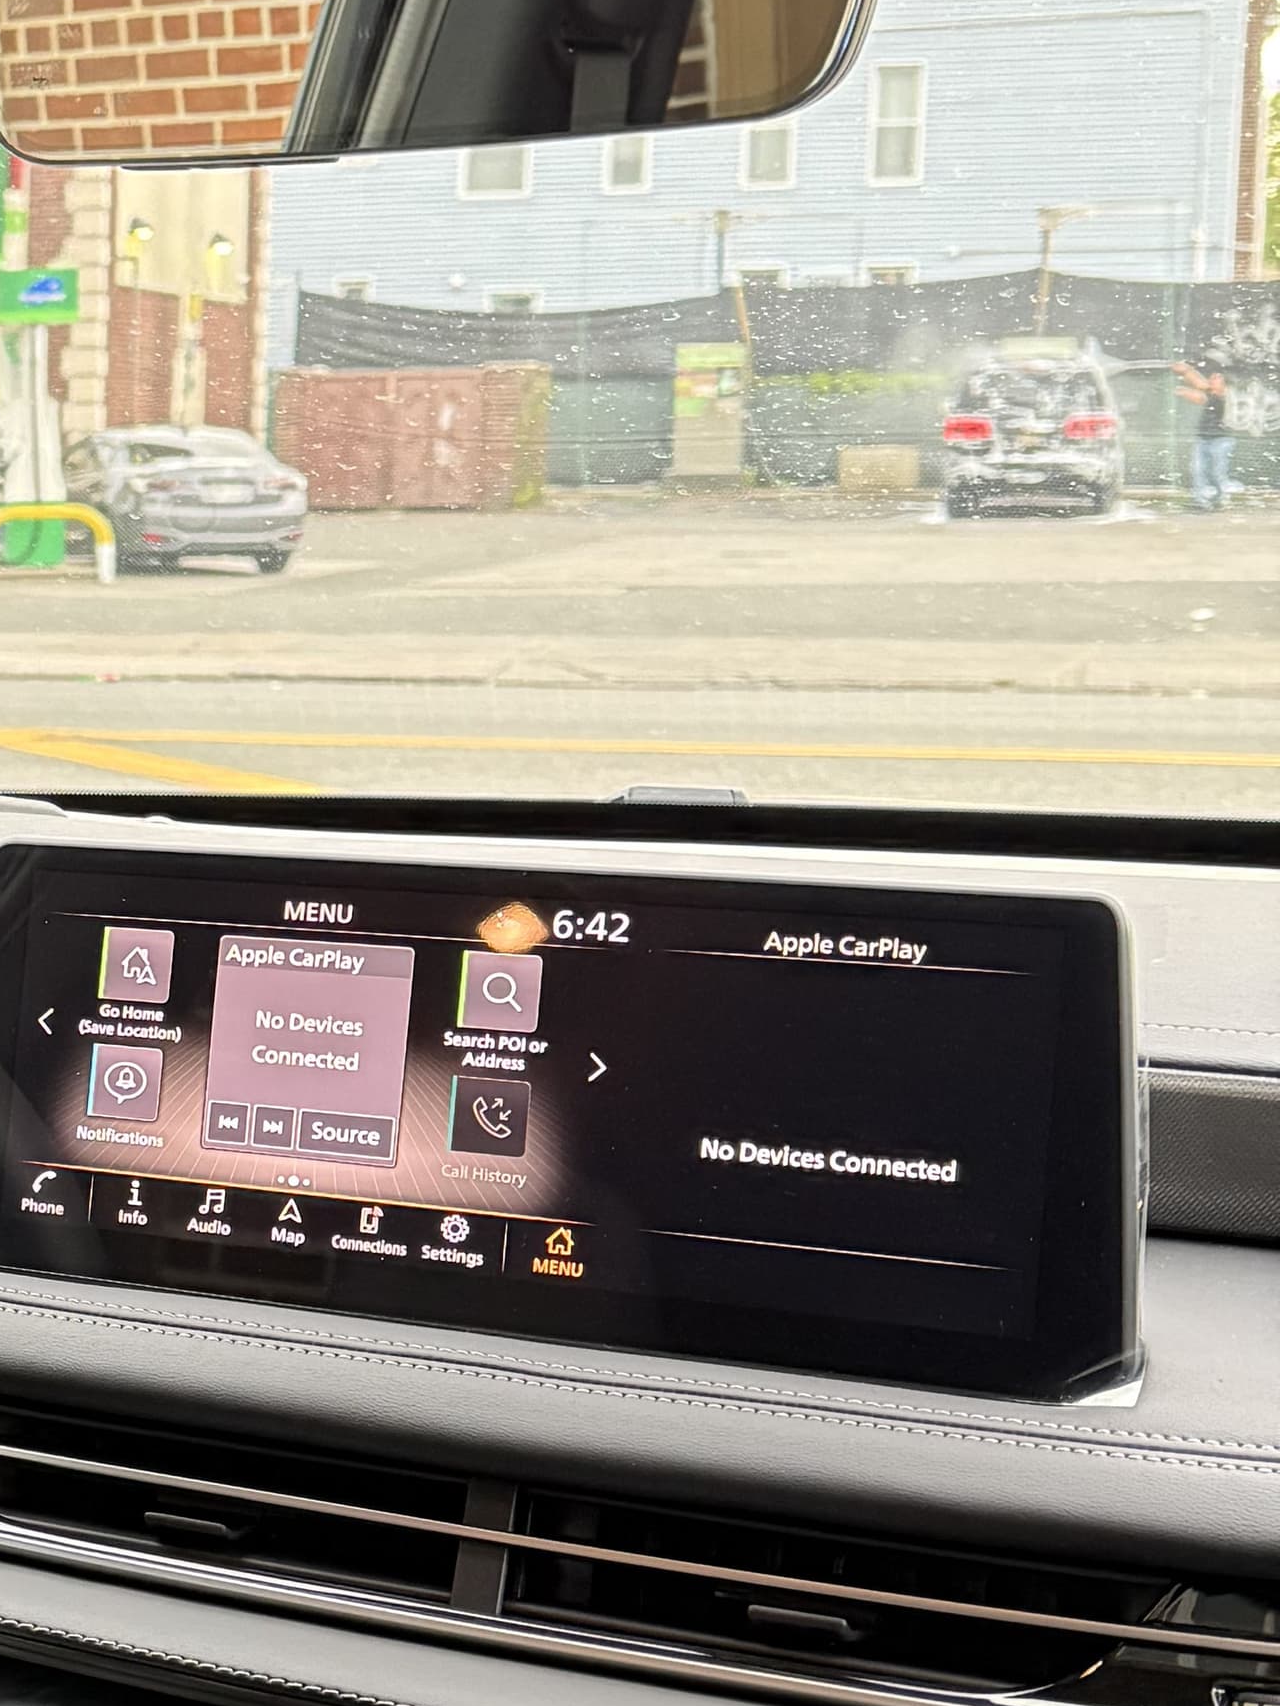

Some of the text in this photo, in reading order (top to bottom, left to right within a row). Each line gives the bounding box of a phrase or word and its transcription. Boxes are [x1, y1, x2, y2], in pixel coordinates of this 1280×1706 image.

[283, 901, 354, 924] MENU
[552, 910, 631, 943] 6:42
[225, 943, 365, 975] Apple CarPlay
[763, 931, 928, 965] Apple CarPlay
[99, 1004, 164, 1022] Go Home
[255, 1010, 364, 1037] No Devices
[78, 1020, 182, 1043] (Save Location)
[443, 1031, 549, 1054] Search POI or
[252, 1045, 360, 1072] Connected
[461, 1051, 526, 1072] Address
[76, 1125, 164, 1148] Notifications
[311, 1121, 381, 1146] Source
[700, 1137, 957, 1182] No Devices Connected
[441, 1163, 527, 1189] Call History
[21, 1198, 65, 1216] Phone
[118, 1209, 148, 1226] Info
[187, 1217, 232, 1236] Audio
[271, 1227, 306, 1247] Map
[330, 1233, 407, 1258] Connections
[421, 1244, 484, 1270] Settings
[531, 1257, 584, 1278] MENU
